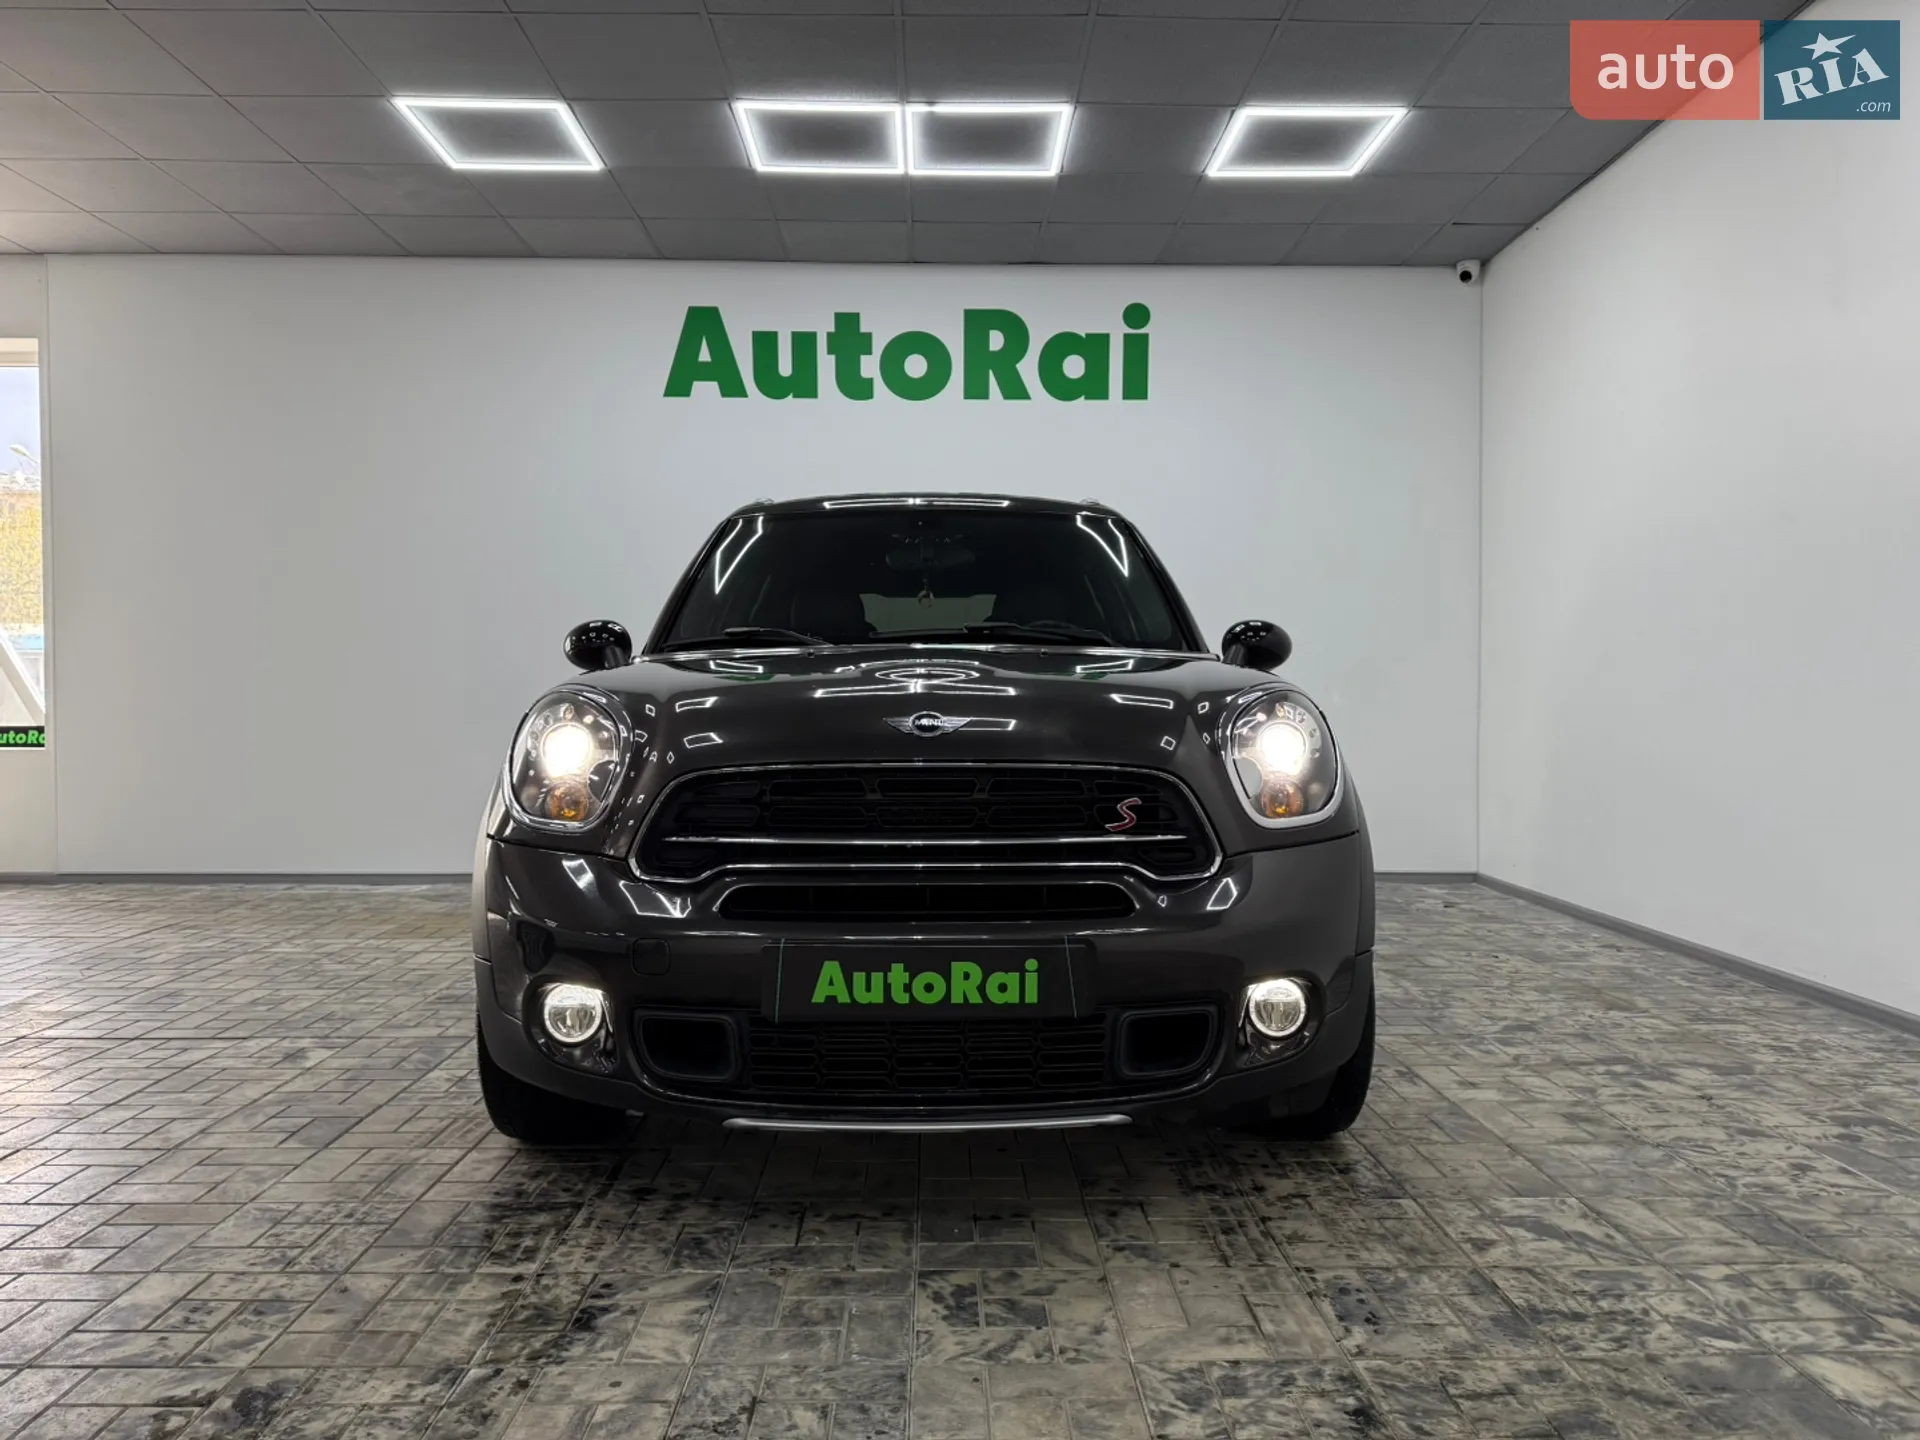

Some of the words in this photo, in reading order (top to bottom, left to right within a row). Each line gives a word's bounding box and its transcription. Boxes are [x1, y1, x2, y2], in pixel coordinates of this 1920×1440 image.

[663, 303, 1152, 402] AutoRai
[1105, 797, 1142, 832] S
[811, 958, 1039, 1005] AutoRai
